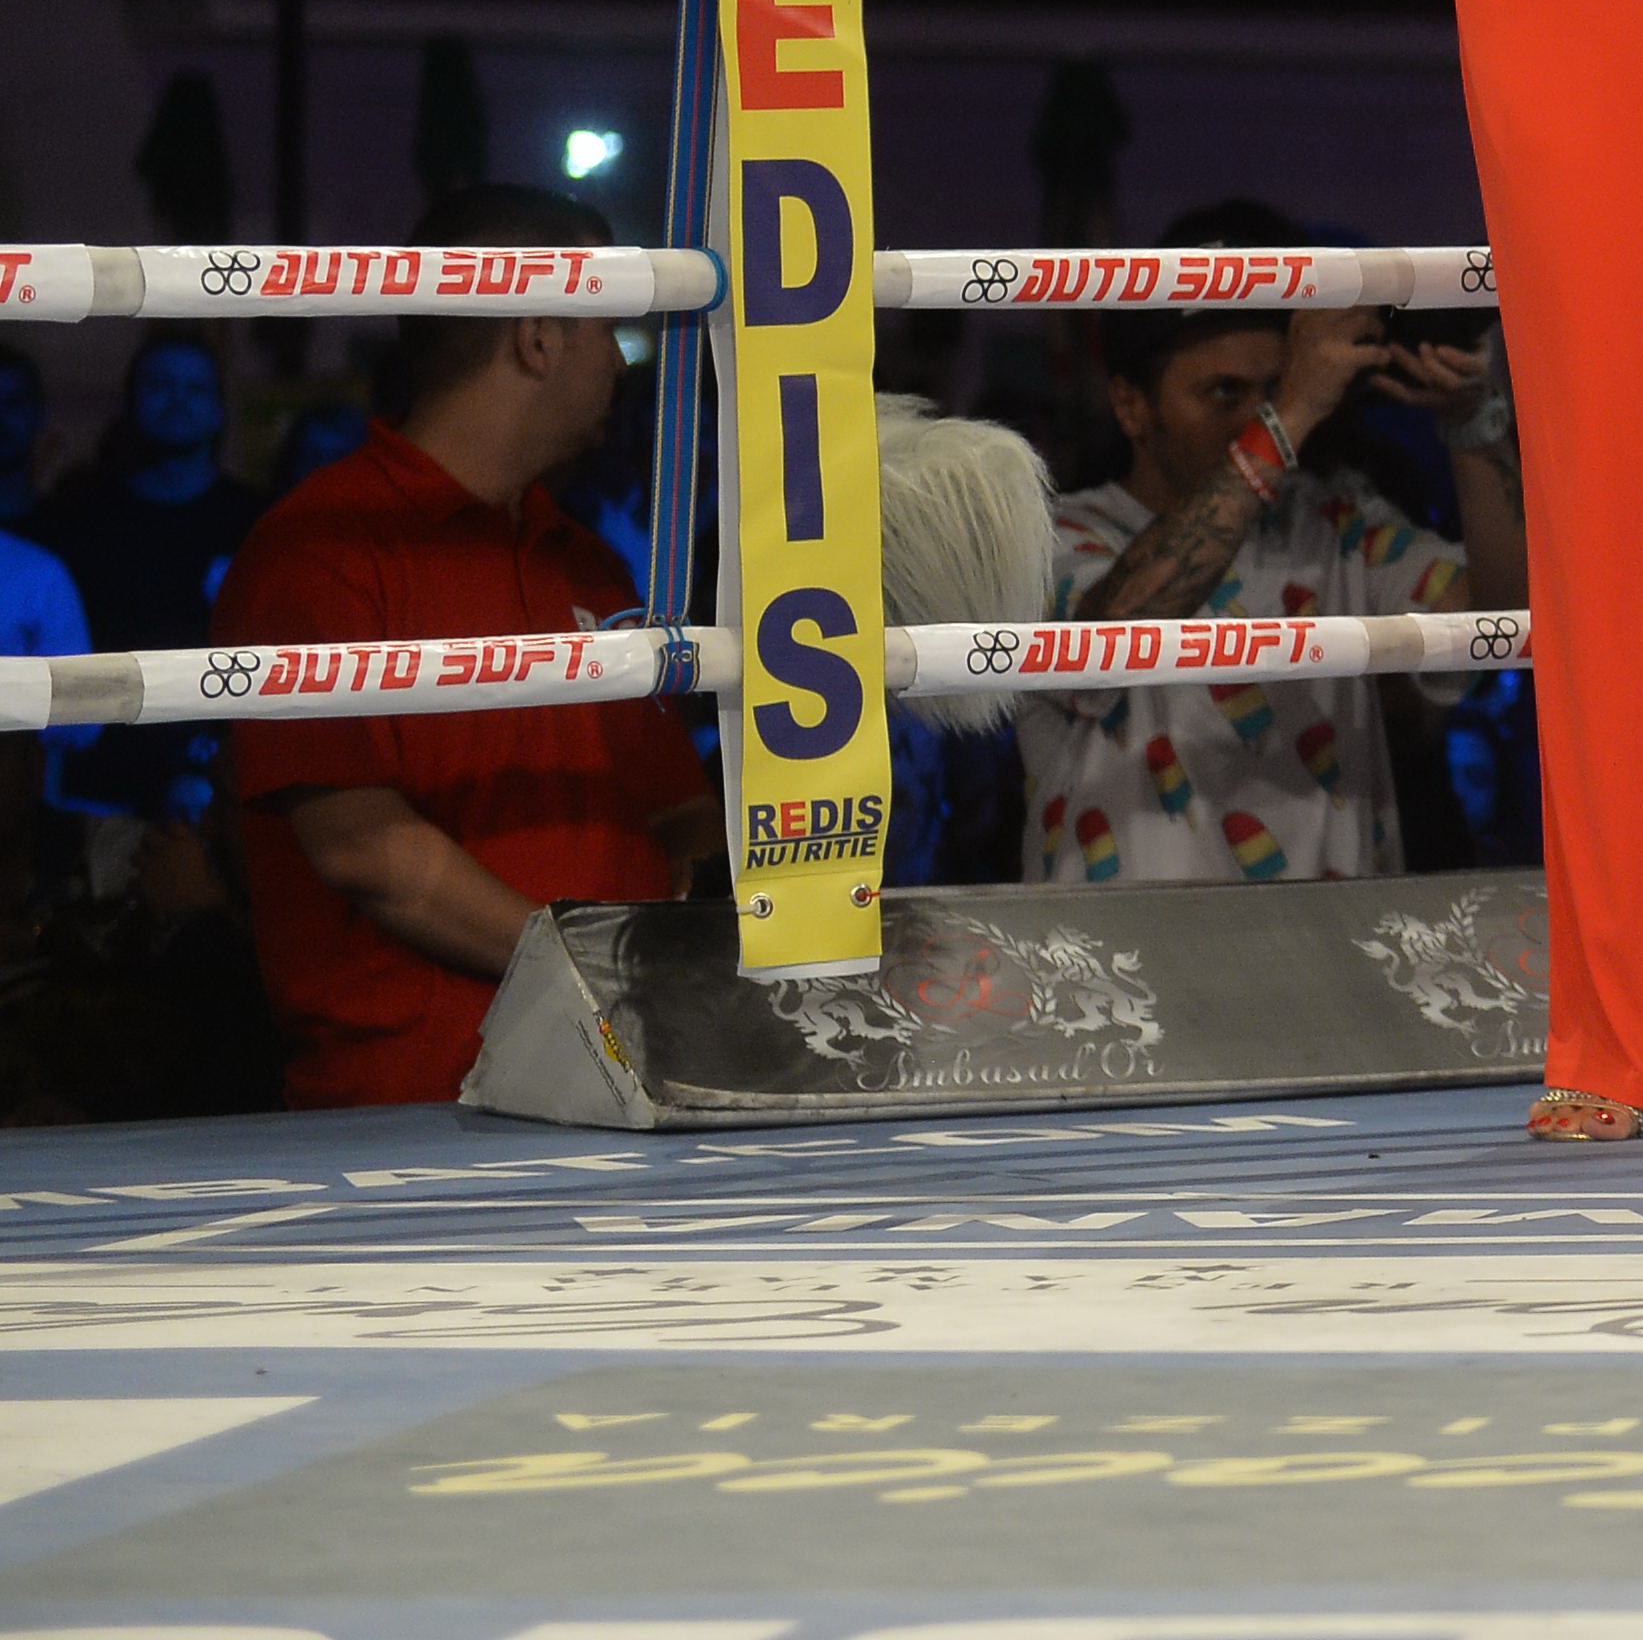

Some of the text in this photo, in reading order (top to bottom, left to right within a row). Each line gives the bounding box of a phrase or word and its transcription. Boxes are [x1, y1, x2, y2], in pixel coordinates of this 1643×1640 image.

[259, 250, 595, 296] AUTO SOFT
[1014, 255, 1312, 304] AUTO SOFT
[258, 635, 594, 696] AUTO SOFT
[1019, 620, 1317, 674] AUTO SOFT
[748, 795, 884, 841] REDIS
[746, 835, 878, 869] NUTRITIE
[552, 1412, 1643, 1437] PIZZERIA
